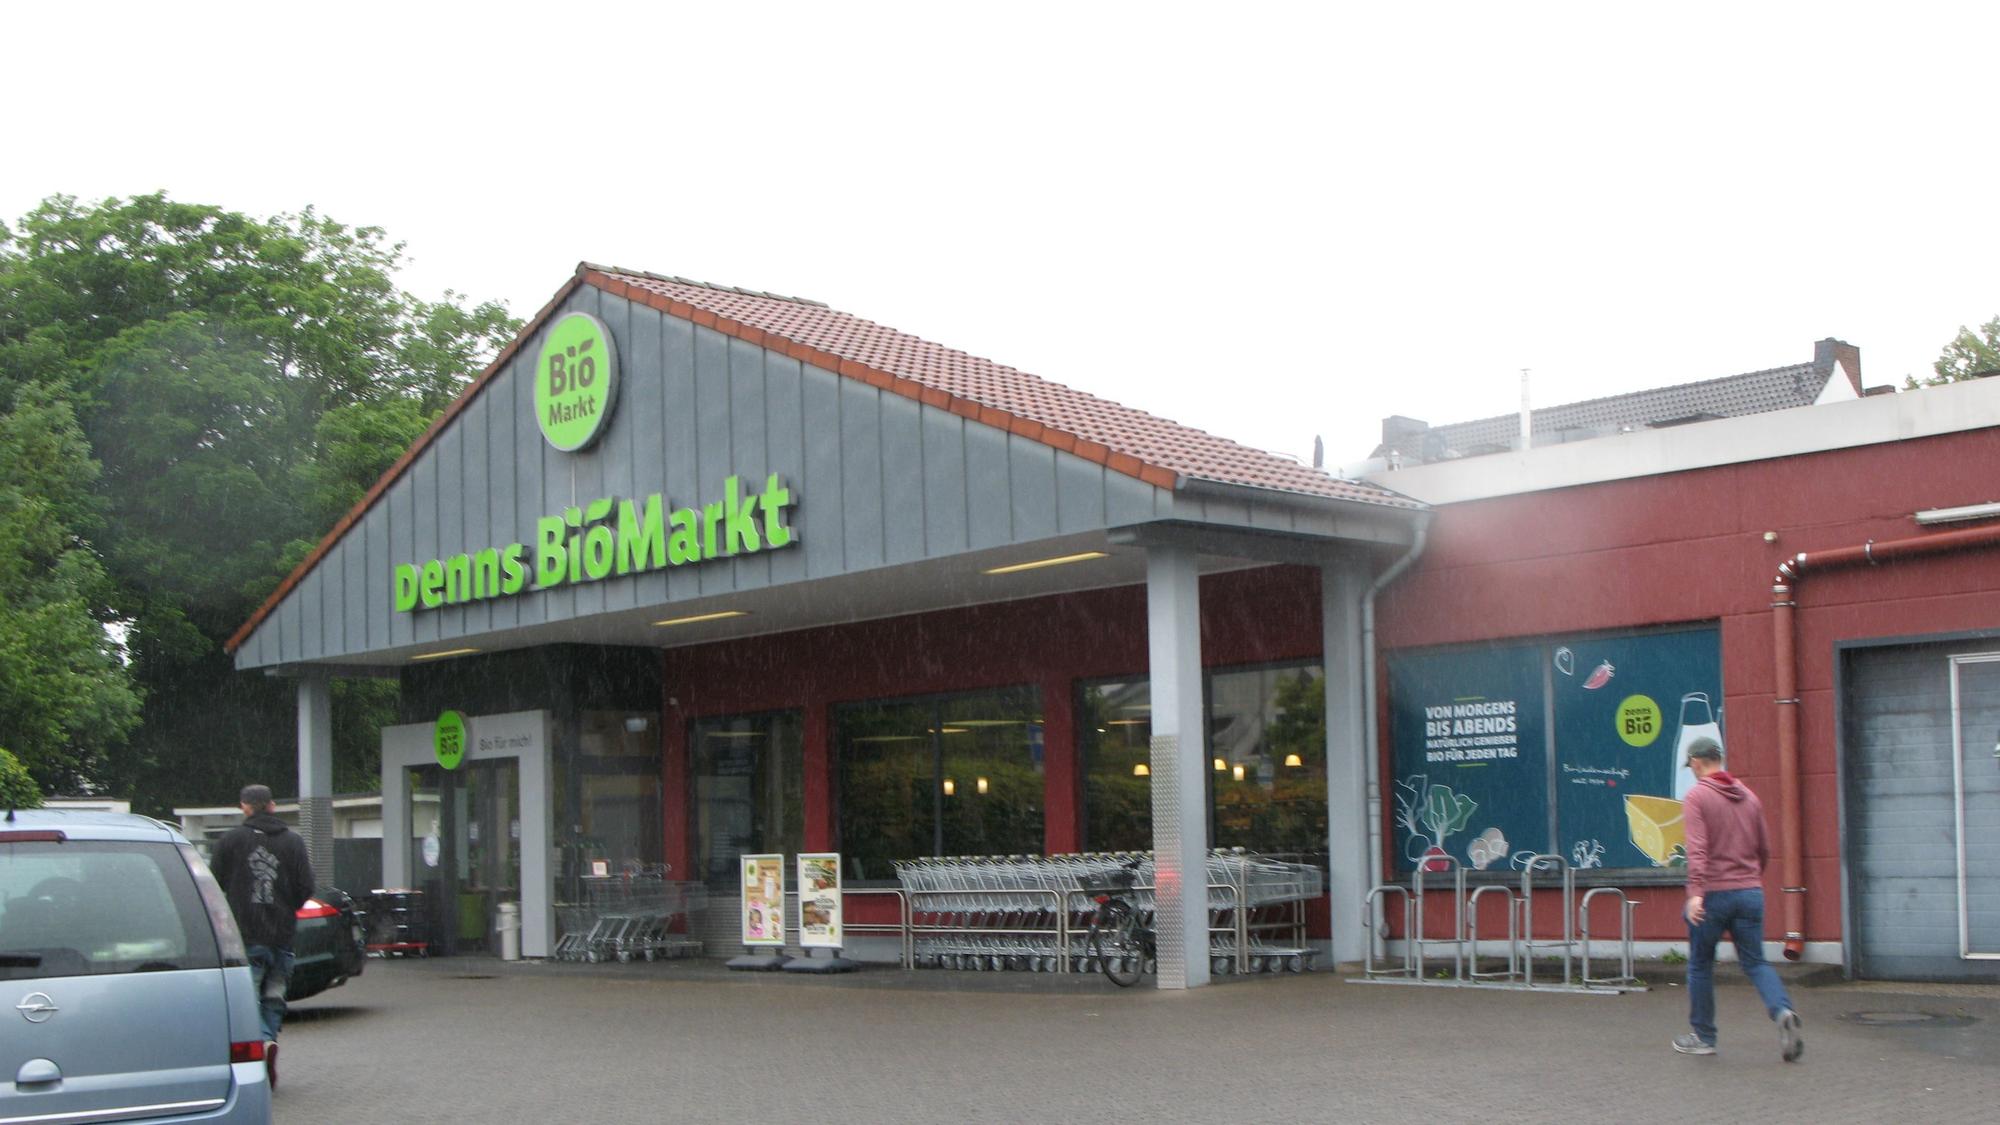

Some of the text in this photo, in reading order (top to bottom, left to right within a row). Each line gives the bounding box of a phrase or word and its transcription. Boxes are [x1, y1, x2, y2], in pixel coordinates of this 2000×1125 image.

[549, 338, 596, 397] Bio
[548, 395, 596, 426] Markt
[537, 471, 794, 589] BioMarkt
[1425, 700, 1516, 719] VON MORGENS
[1425, 715, 1517, 737] BIS ABENDS
[1625, 715, 1652, 735] Bio
[1426, 736, 1473, 749] NATÜRLICH
[1426, 746, 1518, 762] BIO FÜR JEDEN TAG
